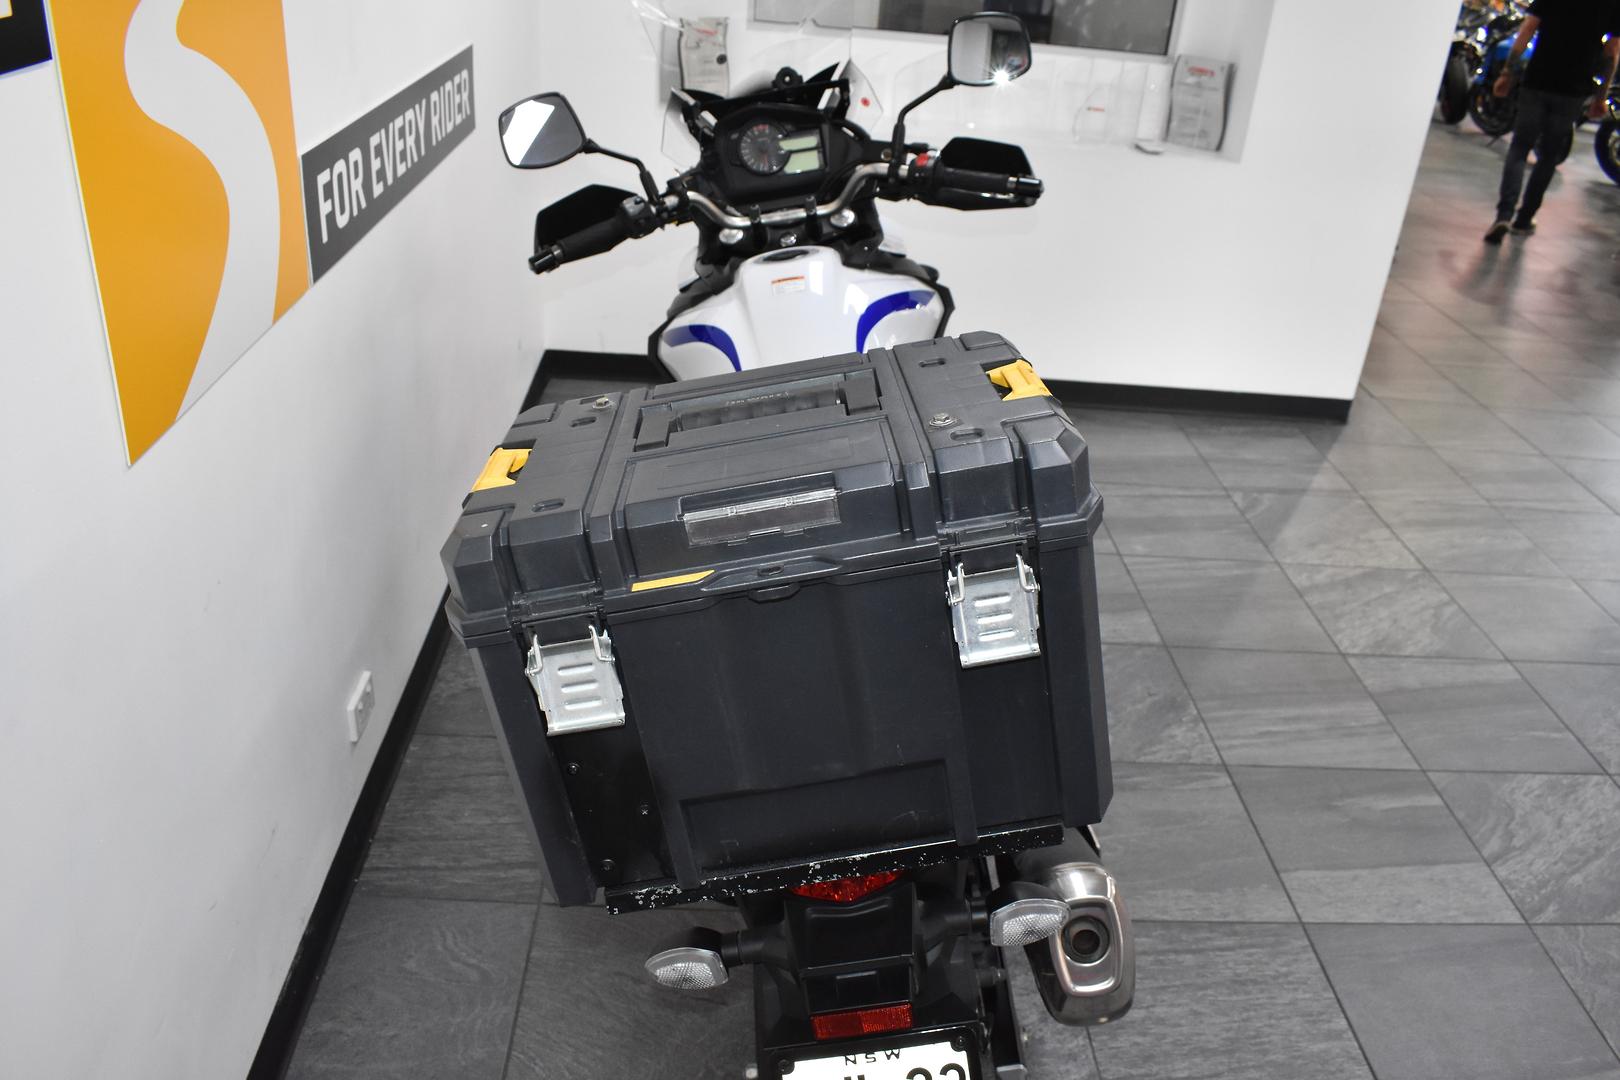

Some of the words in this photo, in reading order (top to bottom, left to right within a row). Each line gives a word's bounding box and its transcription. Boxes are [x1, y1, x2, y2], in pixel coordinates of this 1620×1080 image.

[317, 147, 367, 244] FOR
[369, 98, 426, 199] EVERY
[430, 69, 470, 146] RIDER
